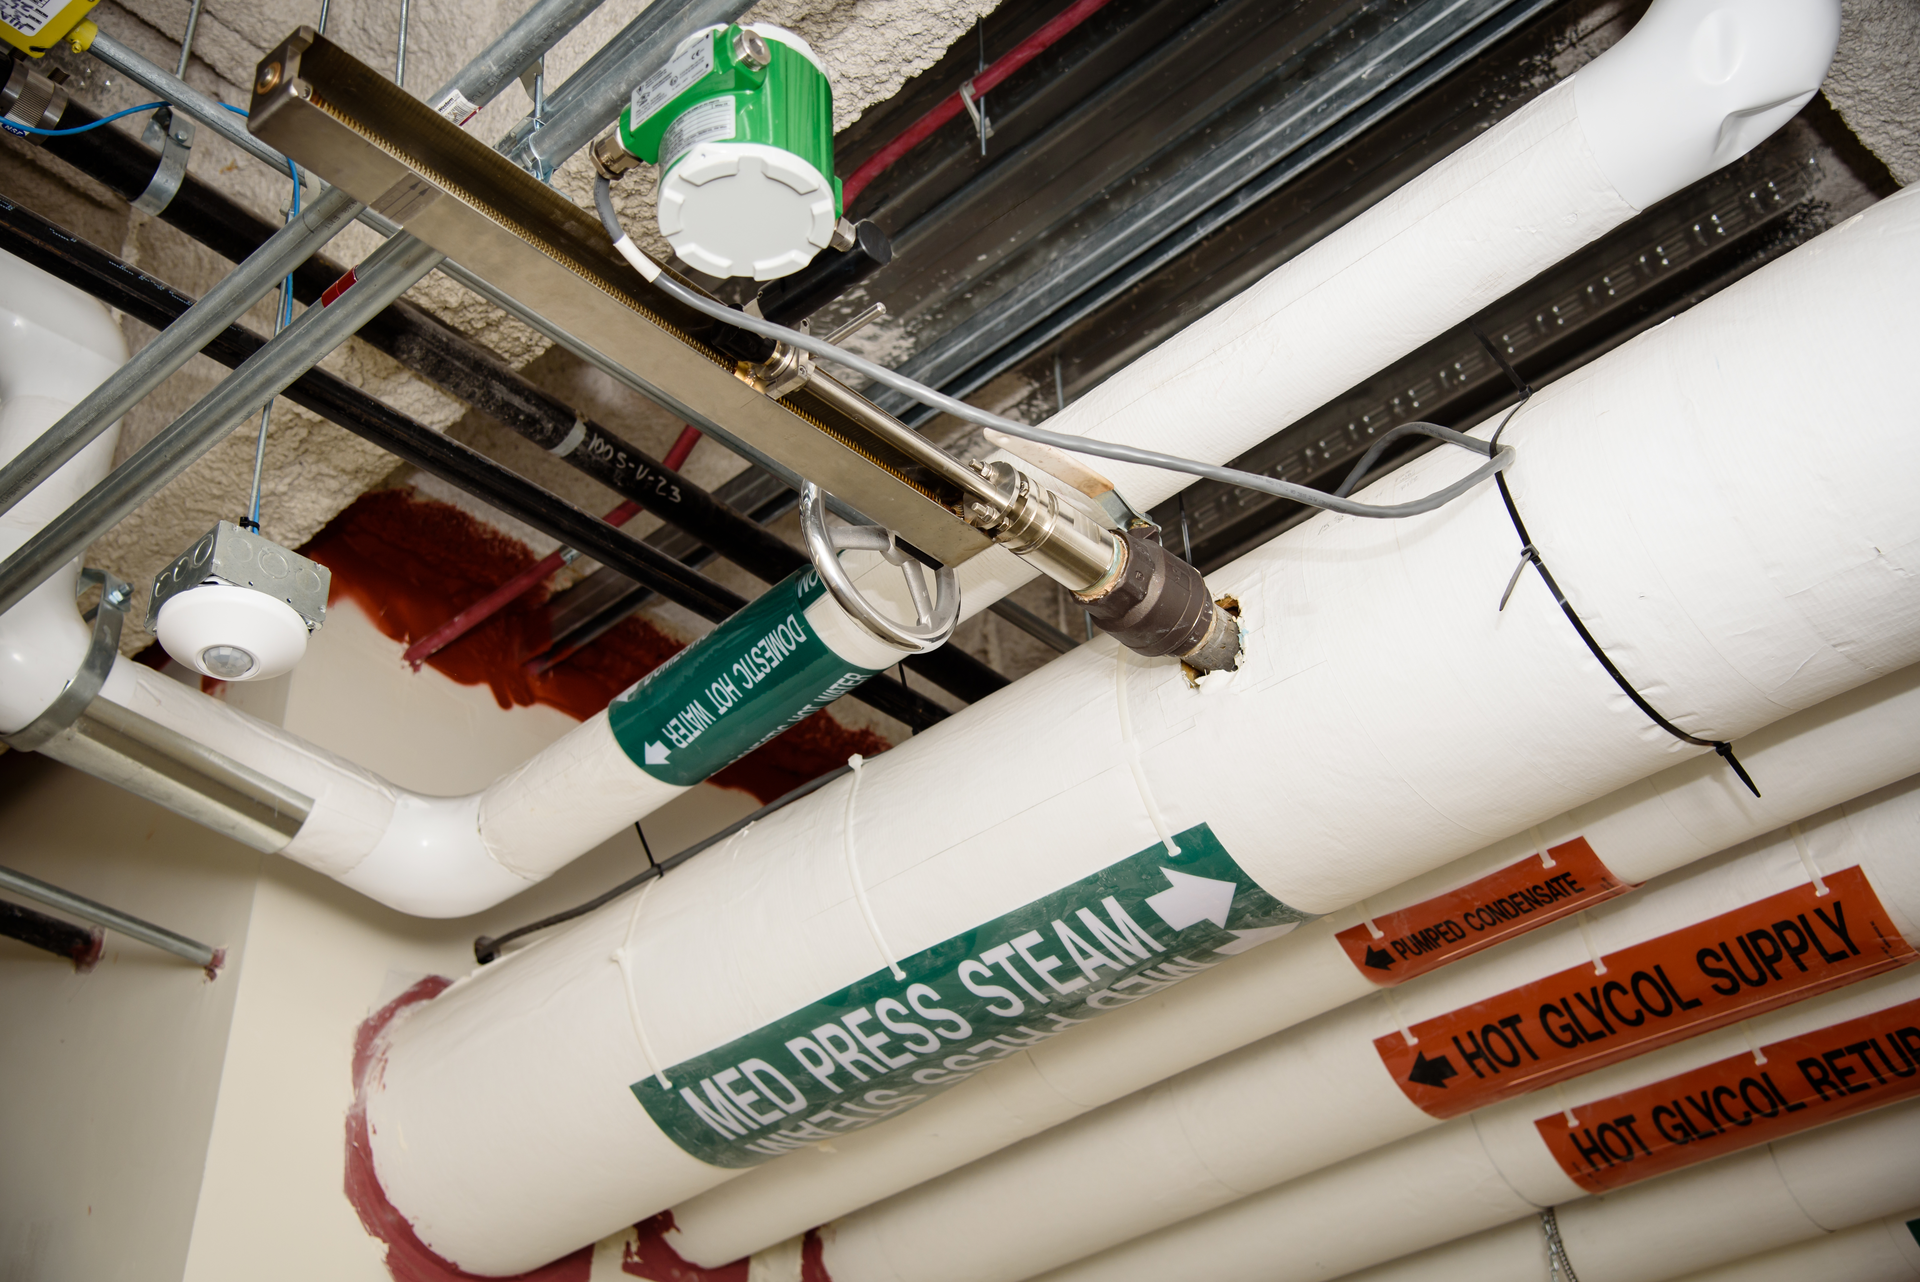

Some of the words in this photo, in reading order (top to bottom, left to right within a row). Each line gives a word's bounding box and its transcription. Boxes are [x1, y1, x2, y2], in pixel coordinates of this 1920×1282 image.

[704, 673, 743, 715] HOT
[732, 613, 807, 689] DOMESTIC
[662, 699, 716, 748] WATER
[1390, 919, 1467, 961] PUMPED
[1463, 871, 1585, 932] CONDENSATE
[679, 1058, 807, 1141] MED
[784, 983, 973, 1094] PRESS
[957, 895, 1167, 1017] STEAM
[1452, 1013, 1540, 1079] HOT
[1538, 964, 1703, 1049] GLYCOL
[1696, 901, 1862, 996] SUPPLY
[1569, 1114, 1653, 1172] HOT
[1652, 1072, 1808, 1145] GLYCOL
